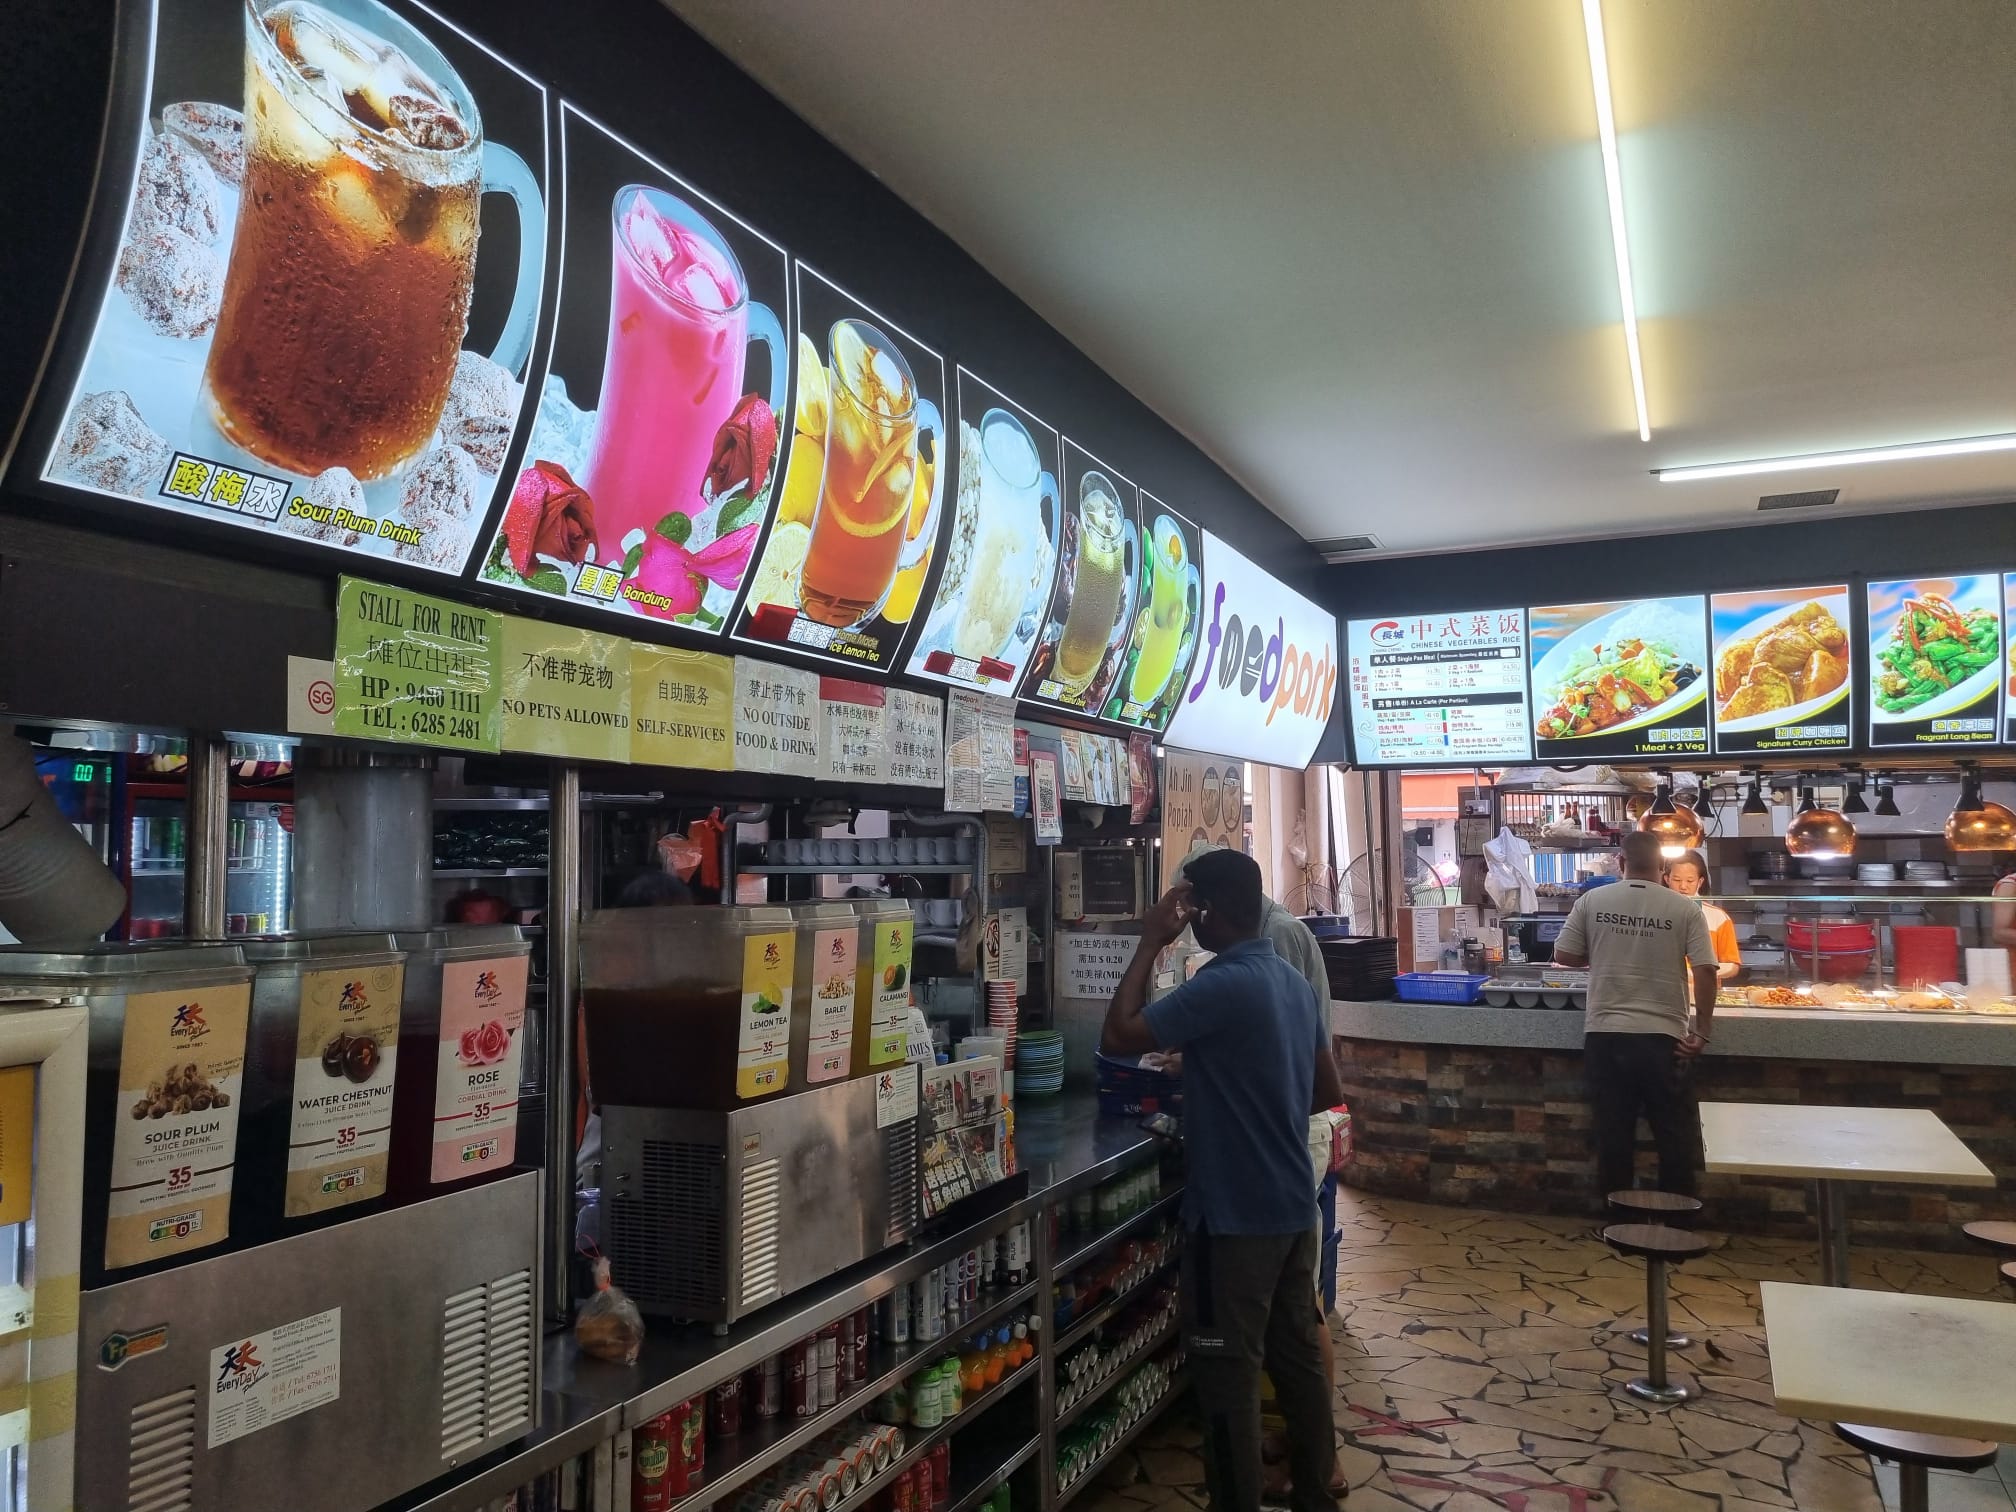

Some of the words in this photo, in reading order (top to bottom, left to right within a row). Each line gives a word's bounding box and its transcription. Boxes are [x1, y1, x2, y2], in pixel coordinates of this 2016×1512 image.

[169, 460, 281, 513] 酸梅水
[289, 496, 331, 522] Sour
[332, 507, 377, 534] Plum
[379, 519, 423, 546] Drink
[577, 568, 620, 597] 曼隆
[623, 585, 672, 611] Bandung
[358, 591, 403, 628] STALL
[413, 603, 440, 635] FOR
[451, 612, 487, 644] RENT
[1410, 613, 1520, 640] 中式菜饭
[829, 640, 842, 653] Ice
[843, 645, 866, 659] Lemon
[866, 649, 880, 662] Tea
[1411, 641, 1443, 649] CHINESE
[1448, 637, 1498, 647] VEGETABLES
[1502, 636, 1520, 644] RICE
[522, 652, 613, 690] 不准带宠物
[312, 690, 333, 705] SG
[360, 675, 389, 699] HP
[451, 691, 480, 714] 1111
[658, 679, 709, 707] 自助服务
[749, 679, 807, 707] 禁止带外食
[360, 703, 397, 729] TEL
[411, 711, 445, 735] 6285
[450, 716, 481, 740] 2481
[502, 698, 525, 715] NO
[529, 702, 561, 721] PETS
[564, 708, 629, 729] ALLOWED
[742, 707, 760, 724] NO
[761, 711, 811, 732] OUTSIDE
[636, 718, 726, 742] SELF-SERVICES
[1915, 733, 1949, 742] Fragrant
[1950, 733, 1970, 741] Long
[1971, 732, 1993, 740] Bean
[736, 731, 767, 749] FOOD
[769, 738, 778, 751] &
[782, 740, 817, 757] DRINK
[1642, 744, 1666, 752] Meat
[1676, 743, 1682, 751] 2
[1684, 742, 1705, 752] Veg
[1756, 740, 1791, 749] Signature
[1792, 739, 1812, 747] Curry
[1814, 738, 1846, 746] Chicken
[1169, 766, 1178, 792] Ah
[1180, 767, 1192, 792] Jin
[1168, 801, 1193, 832] Popiah
[1596, 912, 1672, 930] ESSENTIALS
[1106, 955, 1123, 964] 0.20
[824, 1005, 848, 1015] BARLEY
[890, 1015, 898, 1026] 35
[750, 1018, 774, 1030] LEMON
[776, 1016, 788, 1026] TEA
[830, 1029, 840, 1040] 35
[763, 1041, 773, 1052] 35
[468, 1070, 499, 1086] ROSE
[299, 1095, 339, 1110] WATER
[342, 1084, 393, 1102] CHESTNUT
[458, 1093, 486, 1104] CORDIAL
[487, 1088, 507, 1098] DRINK
[324, 1104, 347, 1114] JUICE
[348, 1100, 371, 1110] DRINK
[474, 1102, 491, 1118] 35
[145, 1129, 181, 1145] SOUR
[185, 1121, 220, 1137] PLUM
[152, 1141, 180, 1152] JUICE
[182, 1135, 212, 1147] DRINK
[337, 1126, 356, 1144] 35
[168, 1166, 192, 1187] 35
[156, 1213, 198, 1228] NUTRI-GRADE
